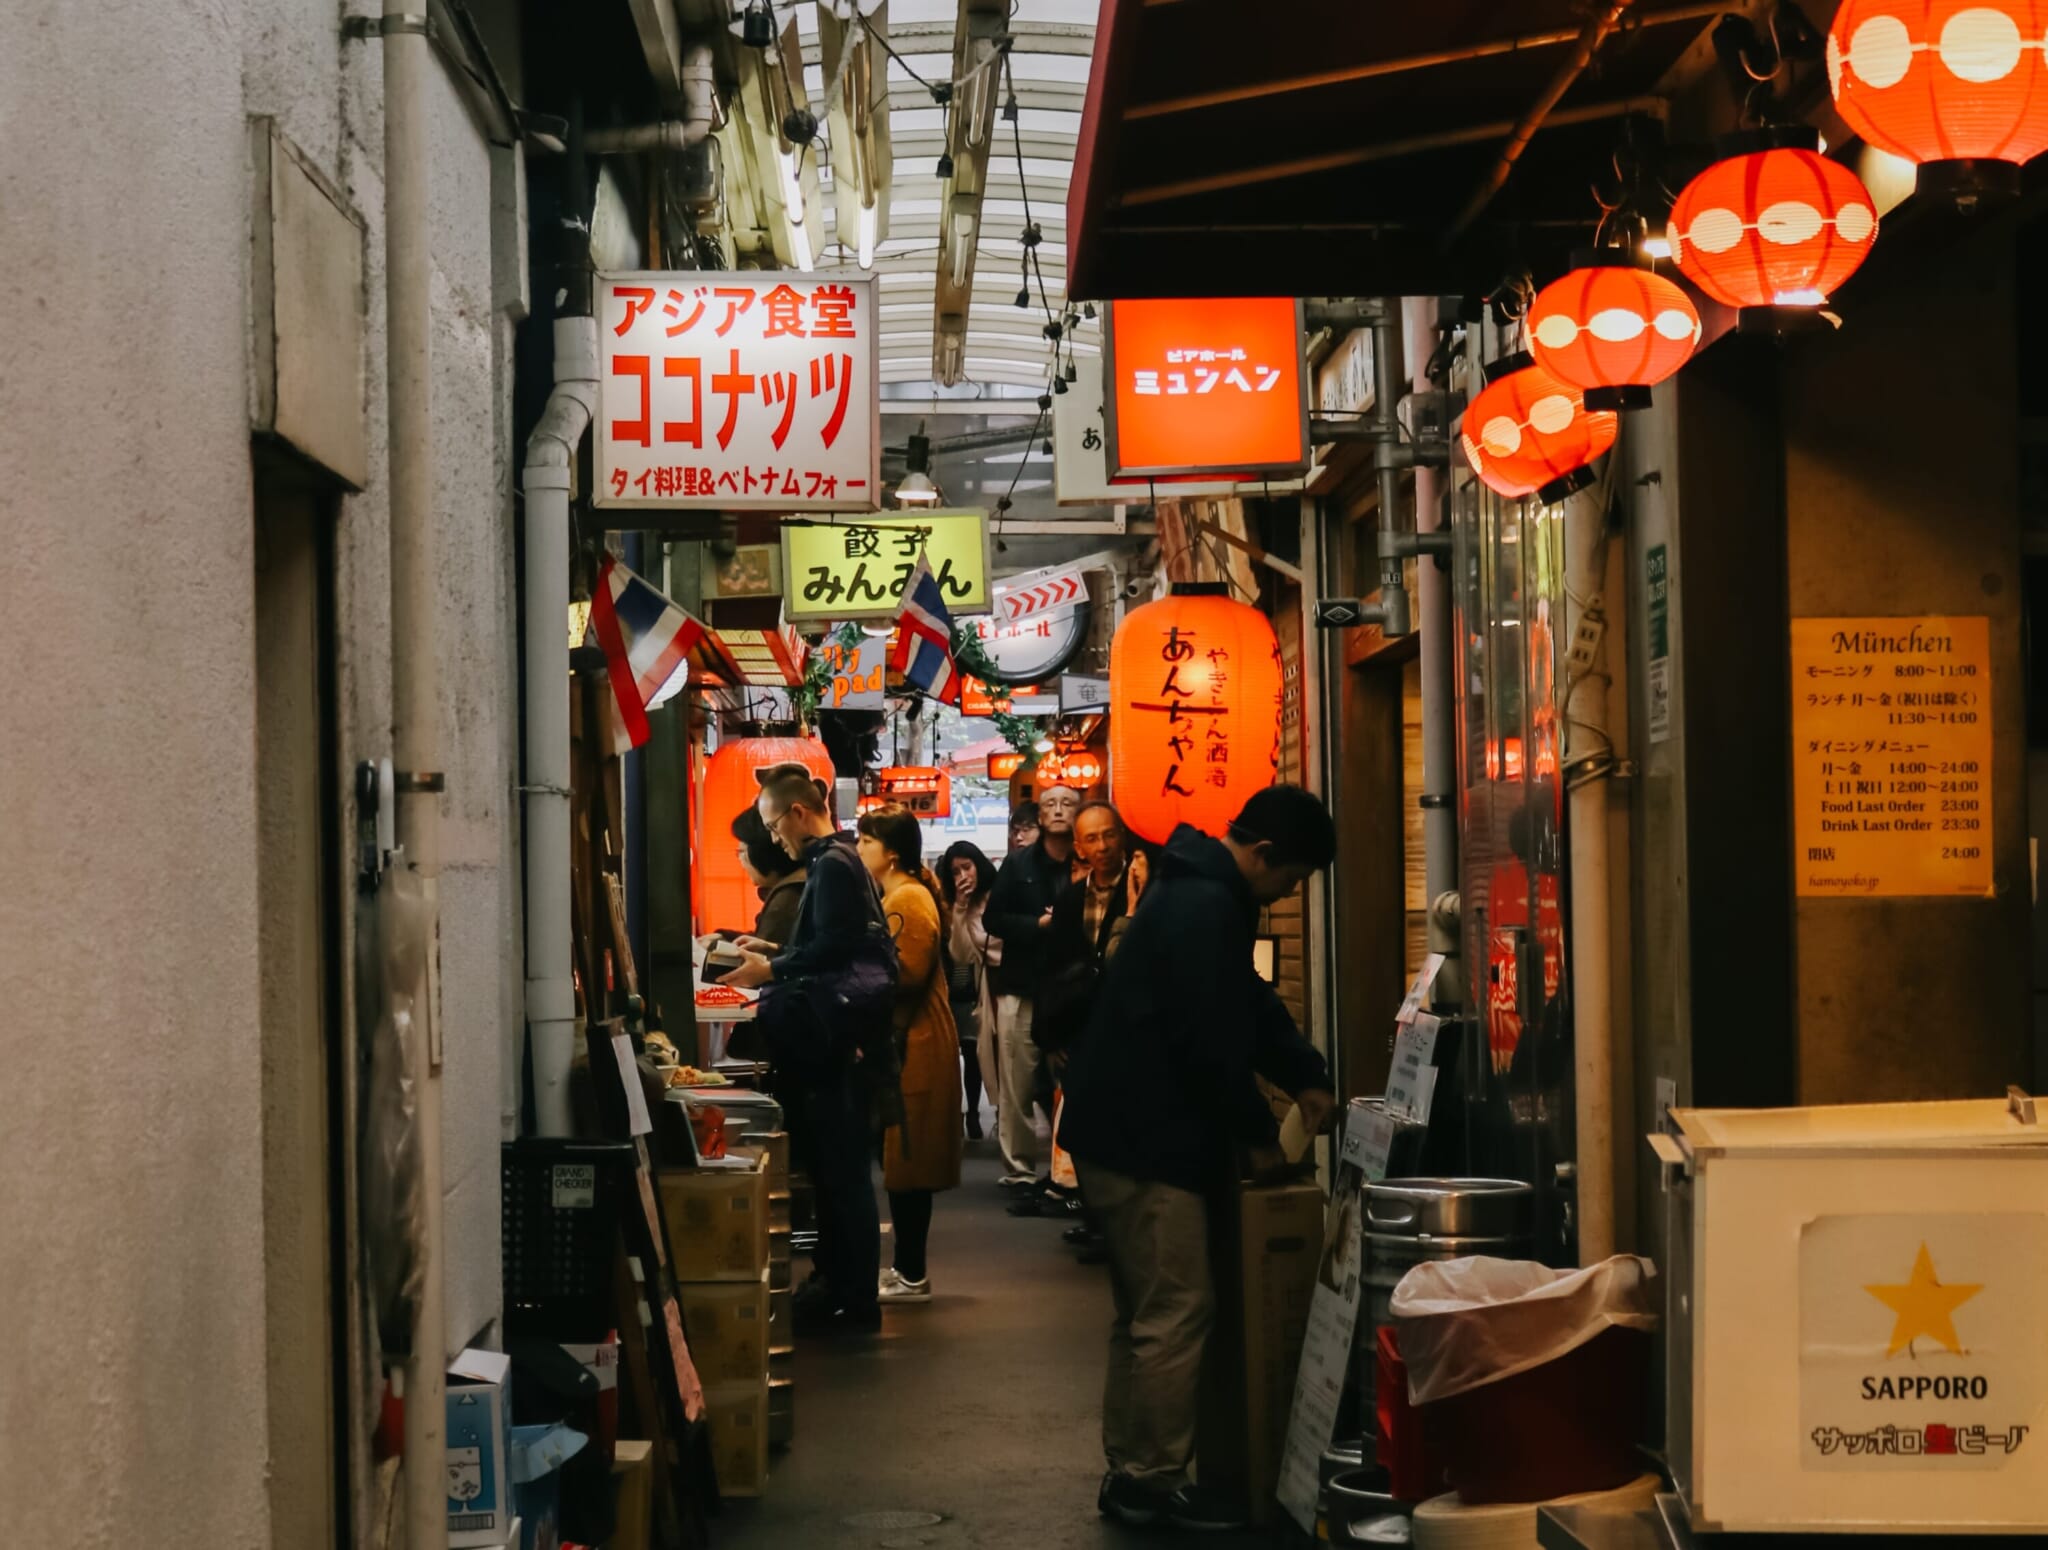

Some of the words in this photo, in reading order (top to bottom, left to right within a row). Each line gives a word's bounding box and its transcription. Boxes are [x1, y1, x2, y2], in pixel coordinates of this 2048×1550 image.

[612, 283, 857, 339] アジア食堂
[1133, 366, 1281, 396] ミュンヘン
[611, 348, 854, 452] ココナッツ
[843, 526, 926, 559] 餃子
[1831, 624, 1953, 655] München
[1805, 664, 1875, 679] モーニング
[1160, 626, 1196, 798] あんちゃん
[1807, 693, 1847, 707] ランチ
[1808, 740, 1930, 755] ダイニングメニュー
[1820, 800, 1854, 813] Food
[1856, 800, 1885, 813] Last
[1887, 799, 1926, 813] Order
[1940, 799, 1980, 812] 23:00
[1820, 819, 1860, 832] Drink
[1863, 819, 1891, 832] Last
[1893, 818, 1934, 832] Order
[1941, 818, 1981, 831] 23:30
[1941, 846, 1981, 860] 24:00
[1861, 1375, 1989, 1401] SAPPORO
